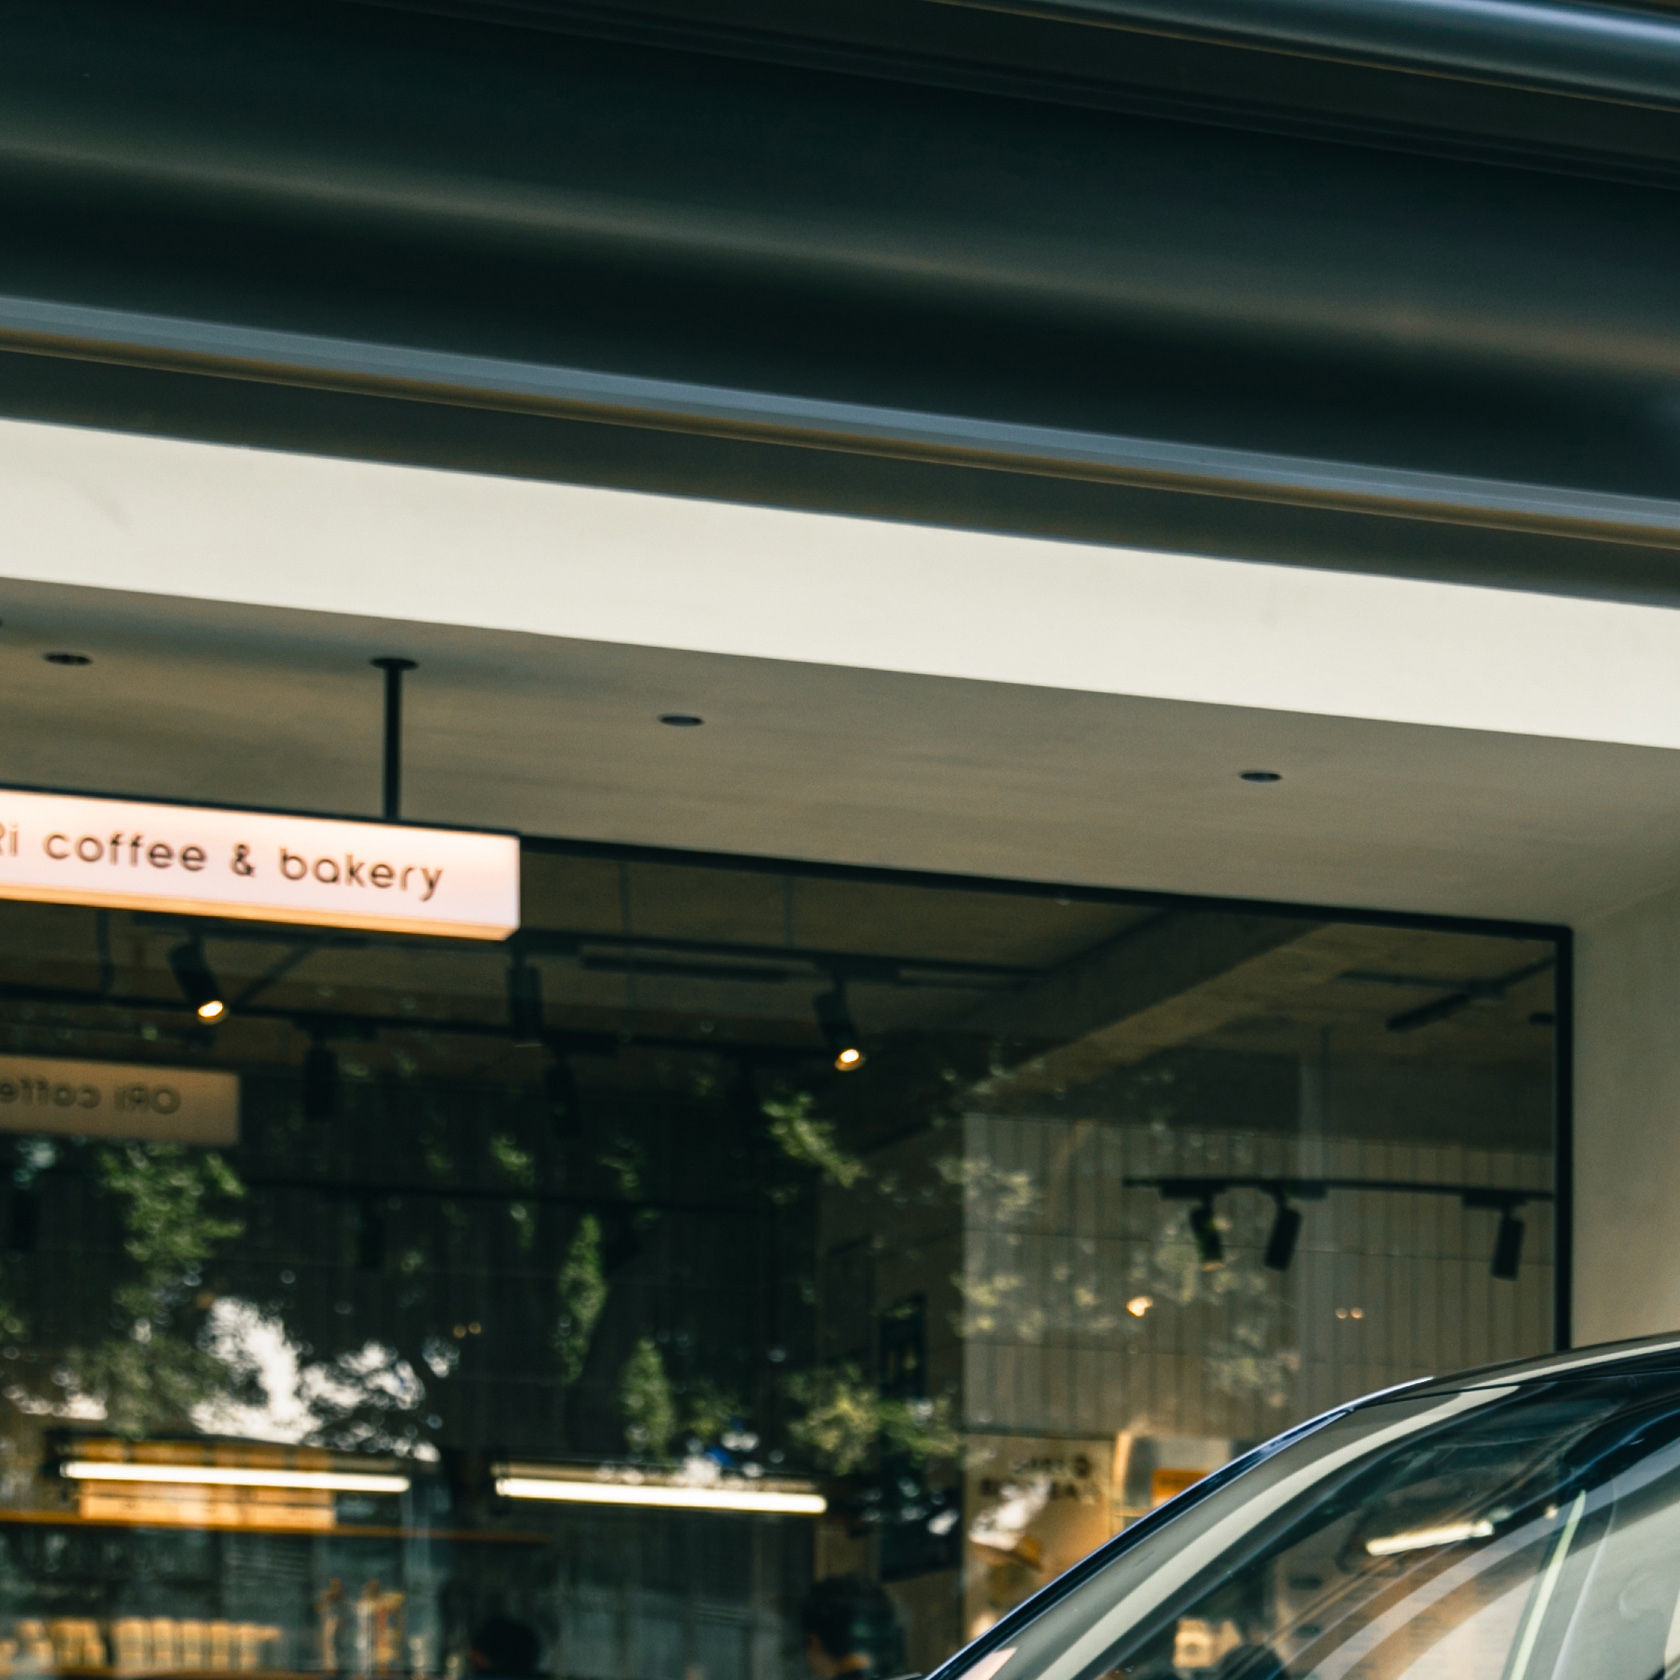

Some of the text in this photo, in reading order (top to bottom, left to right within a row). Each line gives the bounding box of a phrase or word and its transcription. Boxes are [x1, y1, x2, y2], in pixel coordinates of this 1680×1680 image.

[43, 830, 207, 872] coffee
[230, 842, 256, 878] &
[279, 847, 444, 902] bakery
